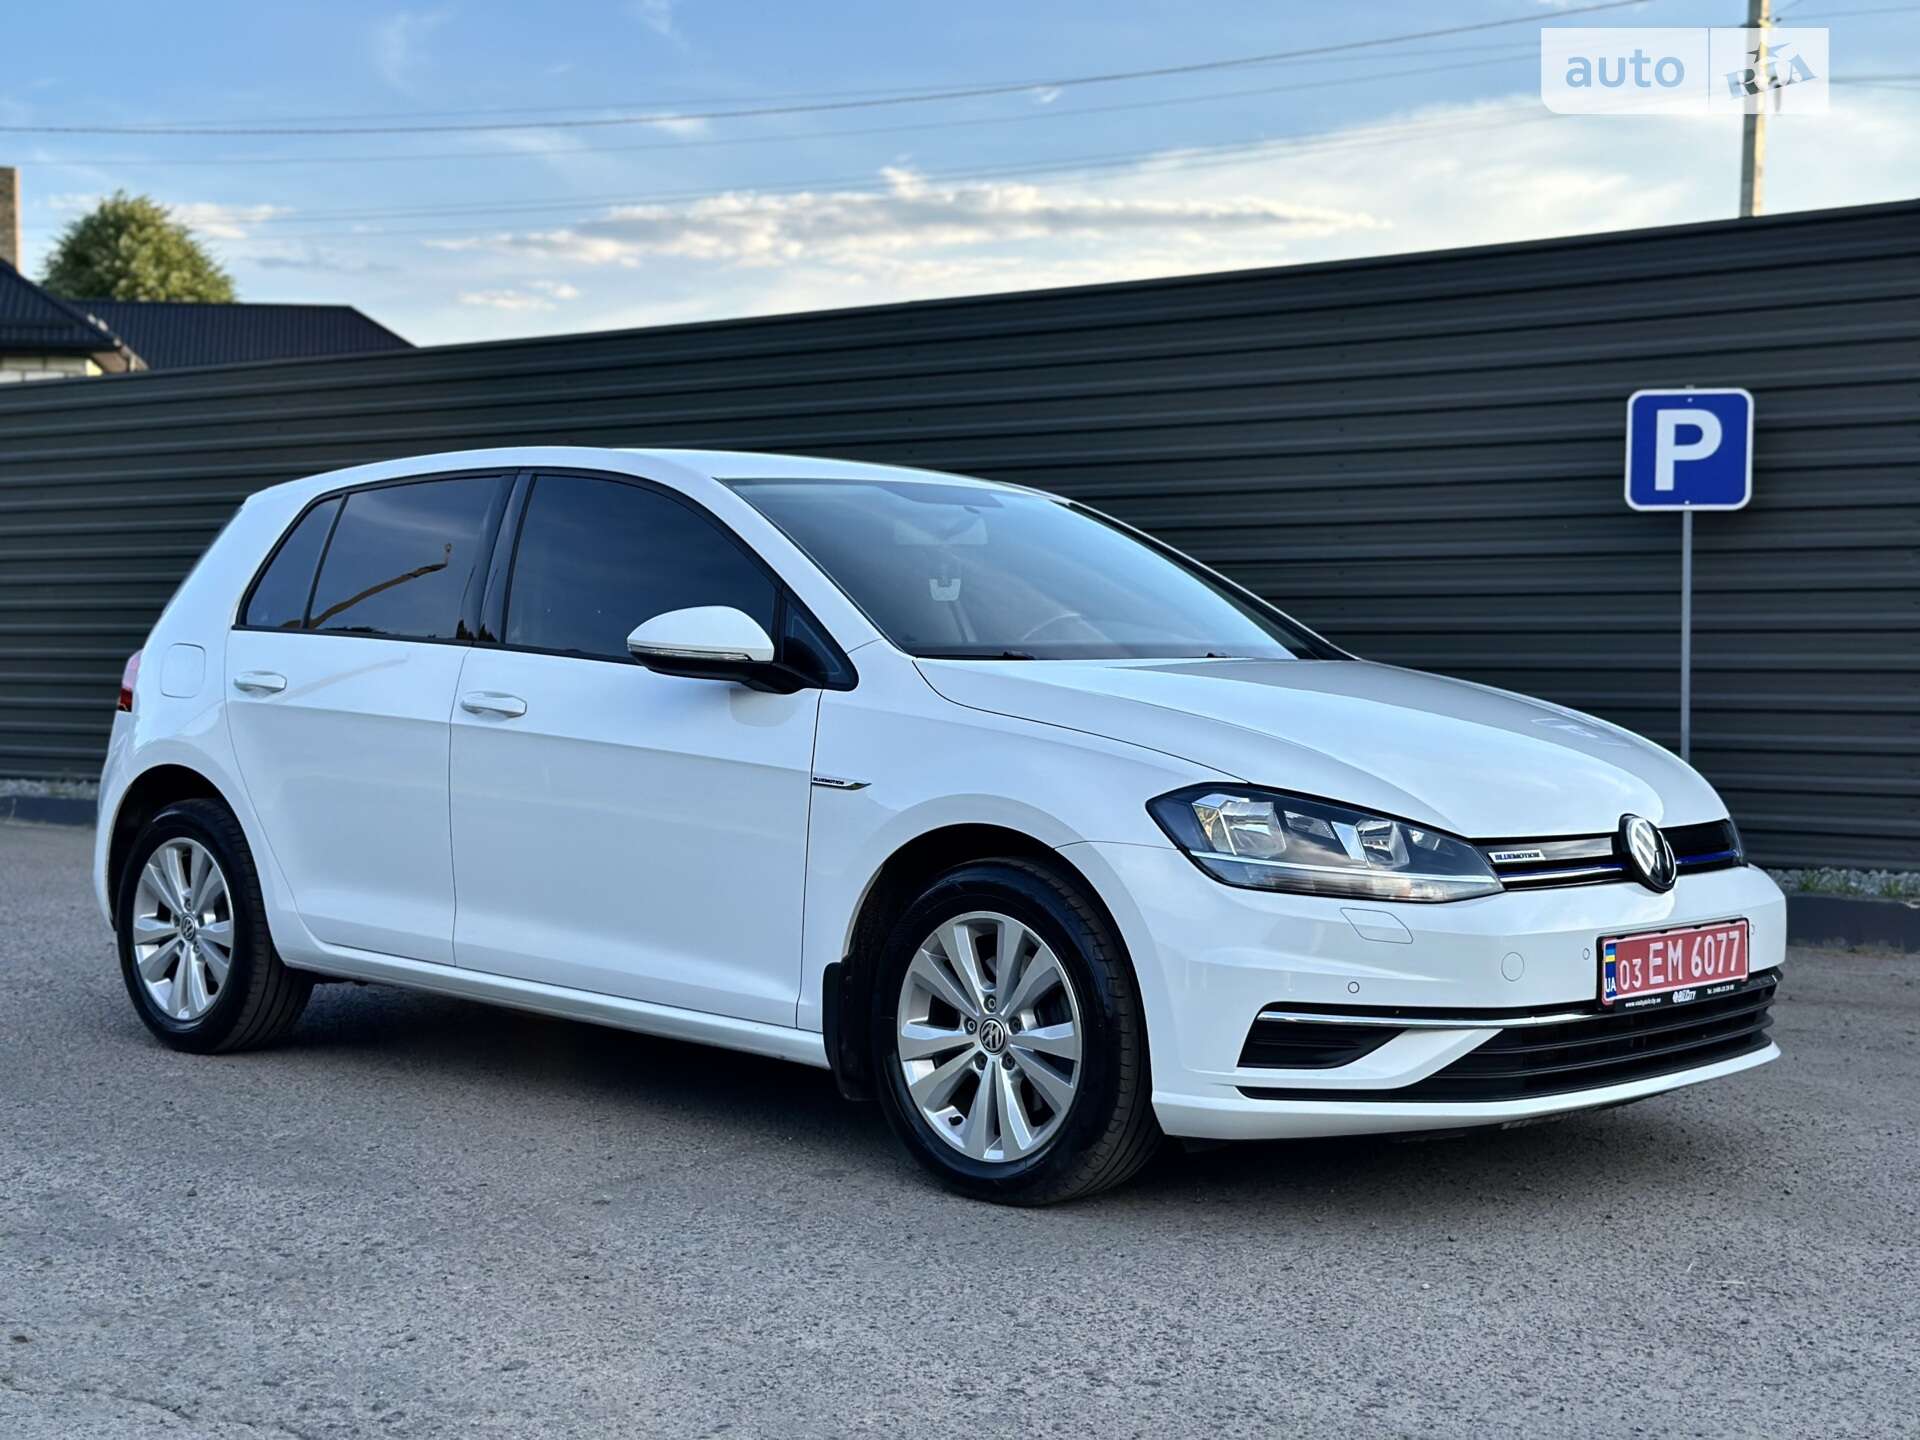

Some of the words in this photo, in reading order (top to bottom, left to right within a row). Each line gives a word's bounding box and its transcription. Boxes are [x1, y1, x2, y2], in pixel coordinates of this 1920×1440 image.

[1655, 408, 1722, 491] P
[1605, 977, 1617, 993] UA
[1619, 958, 1642, 991] 03
[1649, 938, 1684, 985] EM
[1690, 930, 1740, 978] 6077
